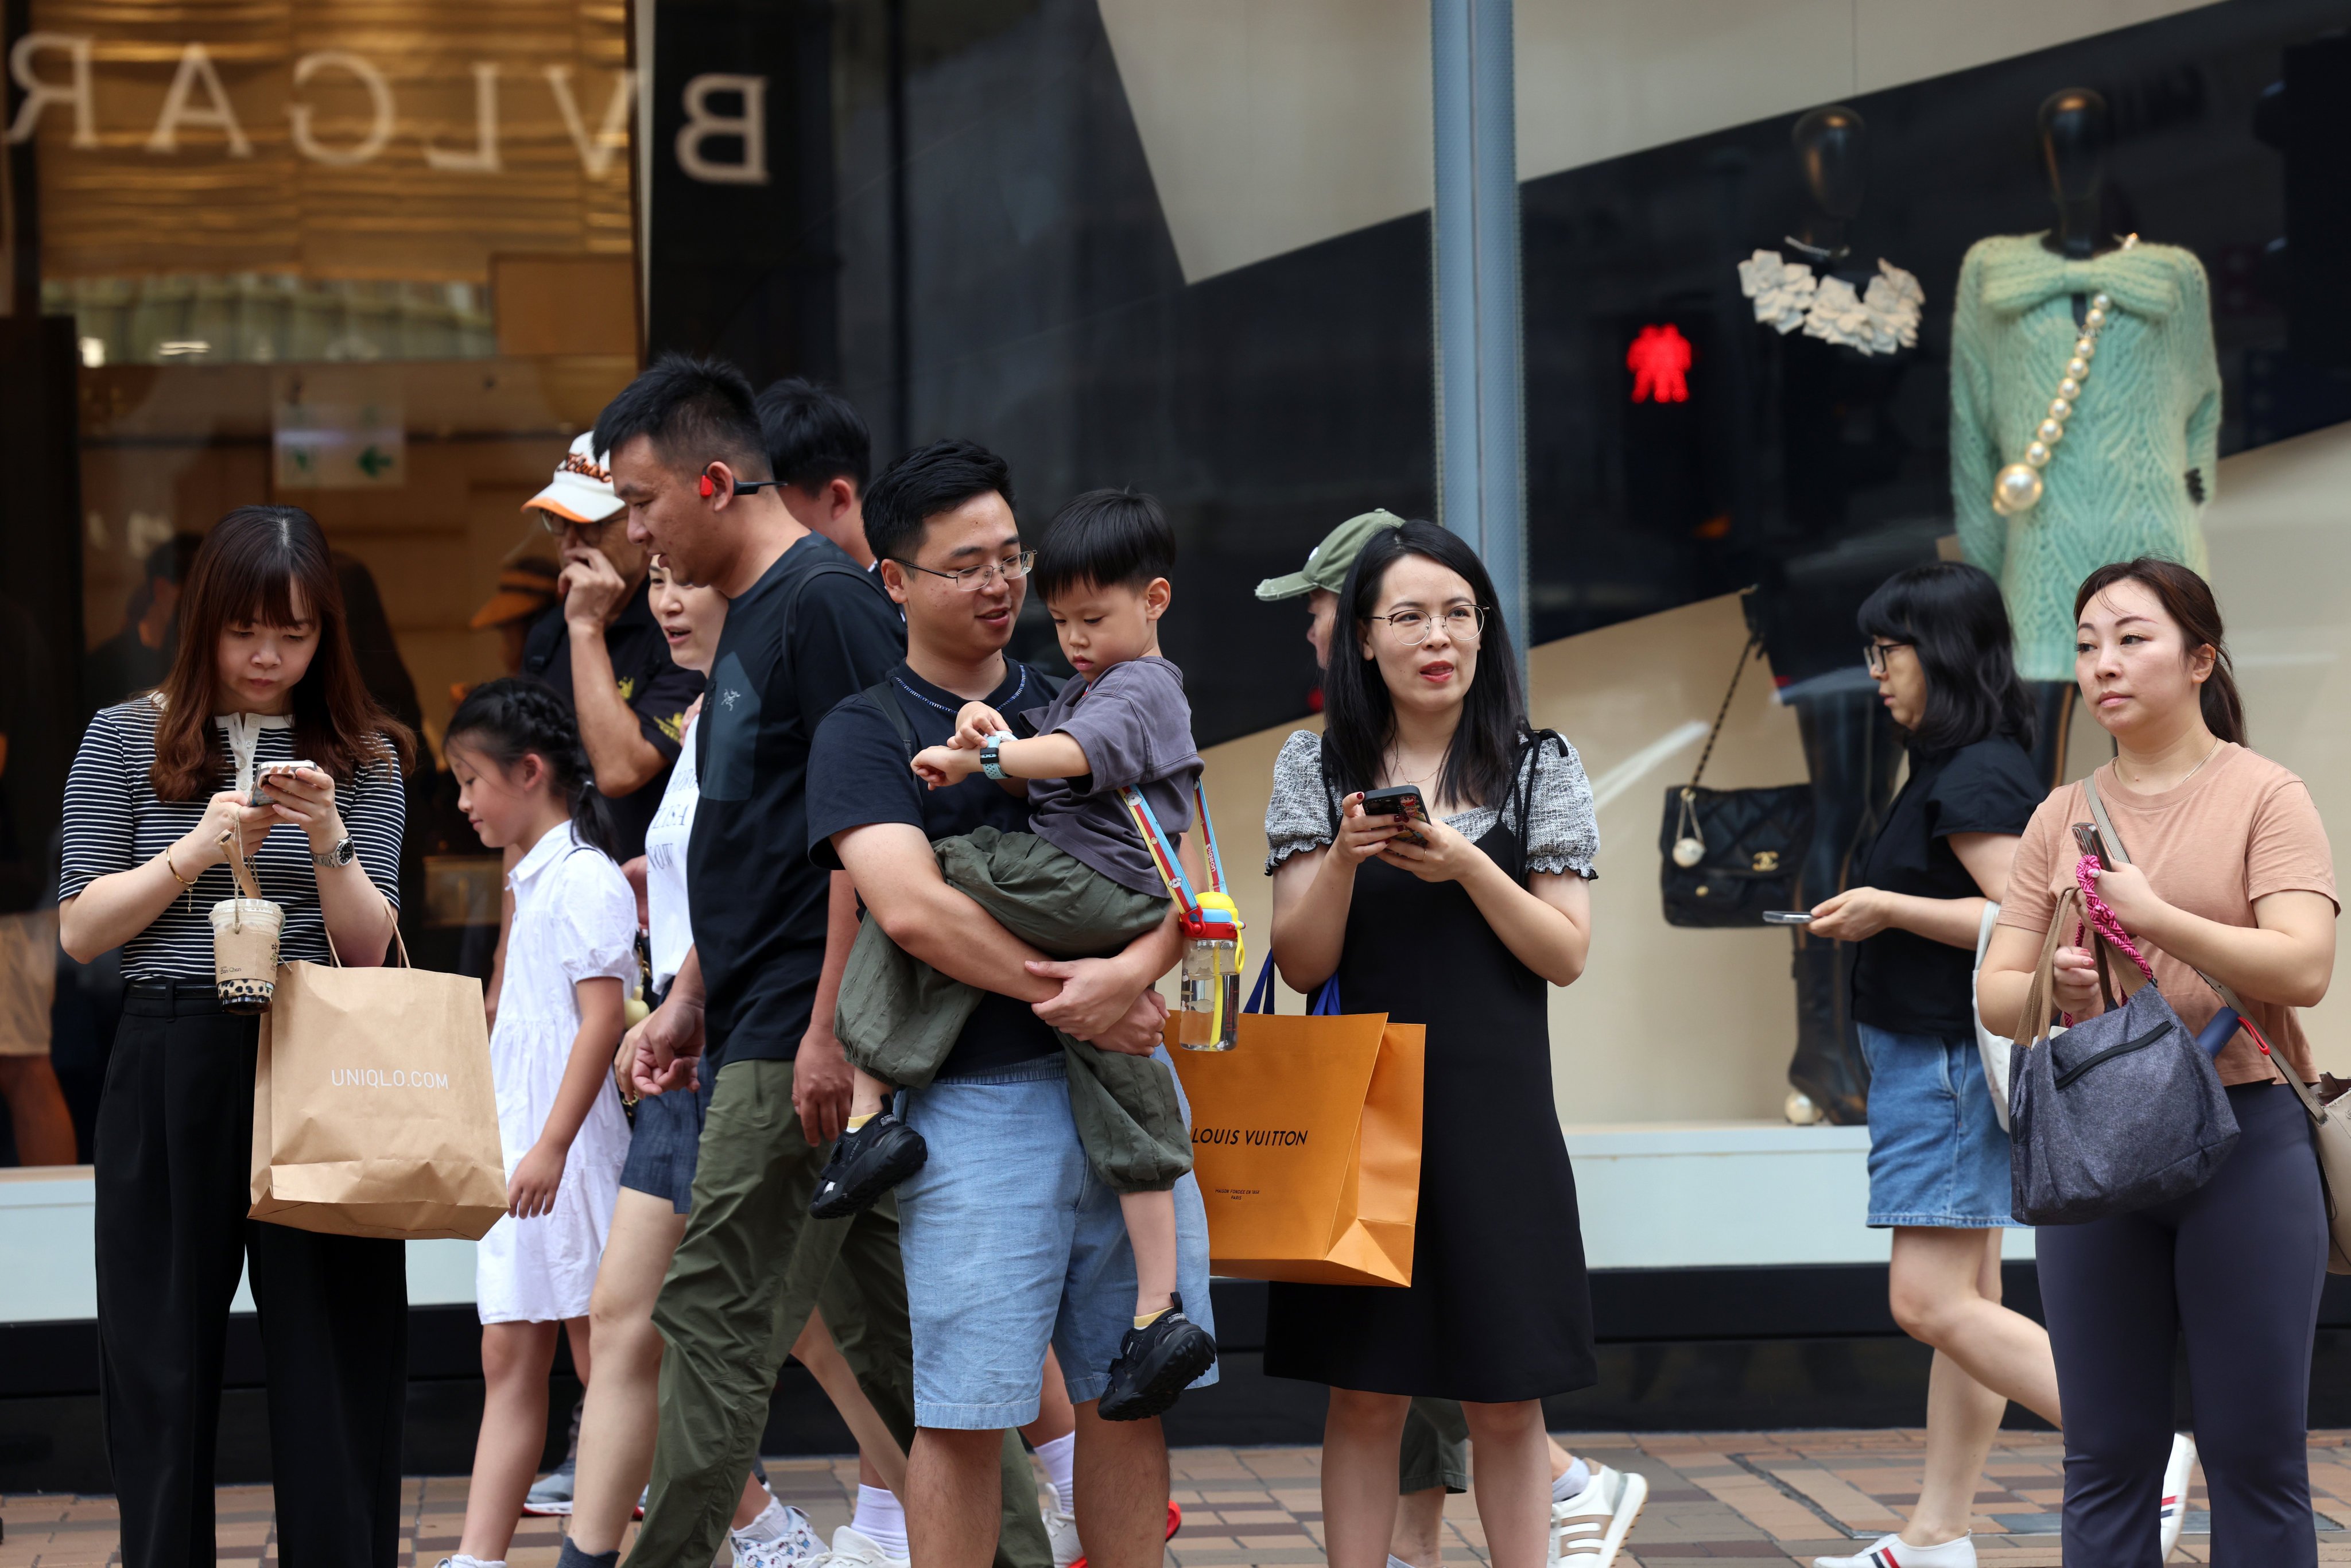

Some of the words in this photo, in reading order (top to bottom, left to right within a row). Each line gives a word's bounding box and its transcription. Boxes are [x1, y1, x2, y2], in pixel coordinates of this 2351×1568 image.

[331, 1068, 449, 1090] UNIQLO.COM
[1191, 1128, 1240, 1145] LOUIS
[1246, 1130, 1308, 1146] VUITTON
